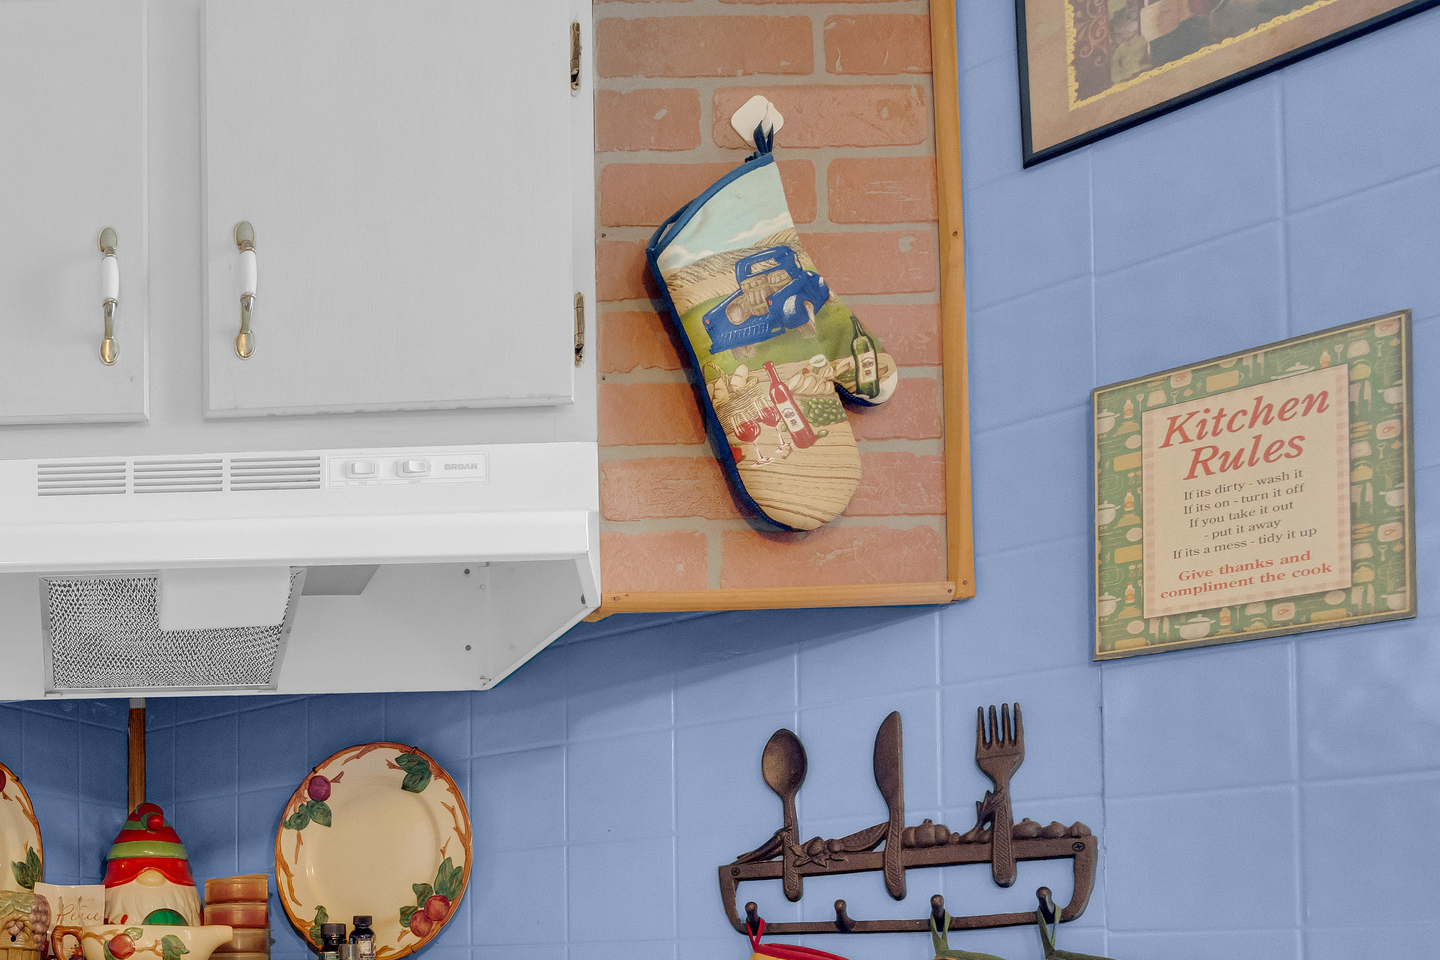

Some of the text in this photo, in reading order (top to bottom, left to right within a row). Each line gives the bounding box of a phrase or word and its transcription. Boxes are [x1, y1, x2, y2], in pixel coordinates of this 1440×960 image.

[1159, 390, 1330, 448] Kitchen
[1183, 434, 1306, 480] Rules
[1184, 490, 1193, 500] If
[1197, 490, 1211, 498] its
[1215, 483, 1245, 494] dirty
[1257, 472, 1289, 485] wash
[1294, 470, 1303, 478] it
[1184, 505, 1193, 514] If
[1197, 504, 1210, 512] its
[1215, 500, 1229, 508] on
[1241, 492, 1268, 503] turn
[1273, 489, 1281, 497] it
[1286, 483, 1305, 494] off
[1189, 502, 1294, 528] If you take it out
[1212, 528, 1232, 540] put
[1236, 525, 1244, 533] it
[1248, 520, 1281, 531] away
[1173, 550, 1182, 559] If
[1185, 549, 1200, 557] its
[1214, 541, 1247, 552] mess
[1259, 533, 1283, 544] tidy
[1287, 530, 1296, 539] it
[1300, 528, 1317, 537] up
[1161, 563, 1332, 599] compliment the cook
[1179, 550, 1311, 581] Give thanks and
